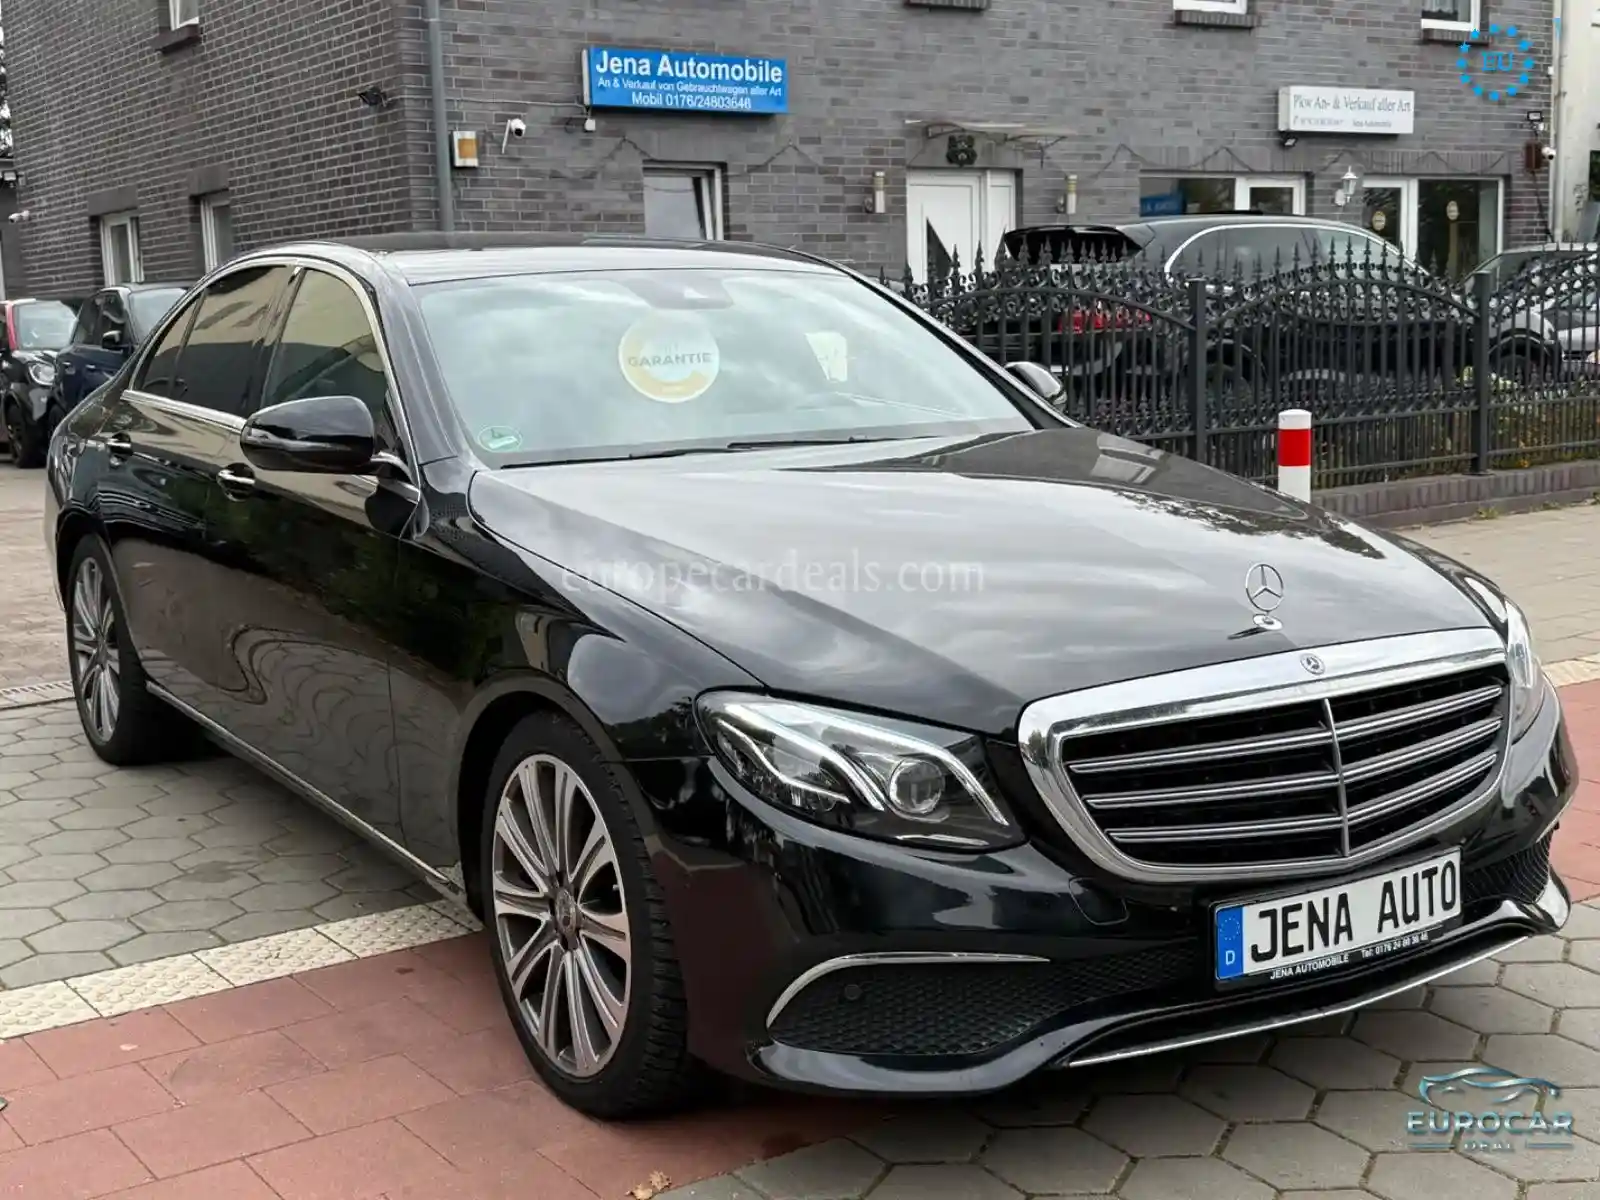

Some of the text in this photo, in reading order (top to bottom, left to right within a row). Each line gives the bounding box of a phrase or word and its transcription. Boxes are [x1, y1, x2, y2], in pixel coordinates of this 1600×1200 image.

[595, 50, 783, 83] Jena Automobile
[597, 76, 611, 88] An
[612, 77, 621, 88] &
[622, 78, 657, 90] Verkauf
[658, 81, 675, 91] von
[768, 86, 782, 97] Art
[631, 91, 662, 106] Mobil
[627, 351, 713, 367] GARANTIE
[1250, 860, 1457, 963] JENA AUTO
[1225, 950, 1236, 966] D
[1270, 967, 1294, 980] JENA
[1294, 952, 1350, 976] AUTOMOBILE
